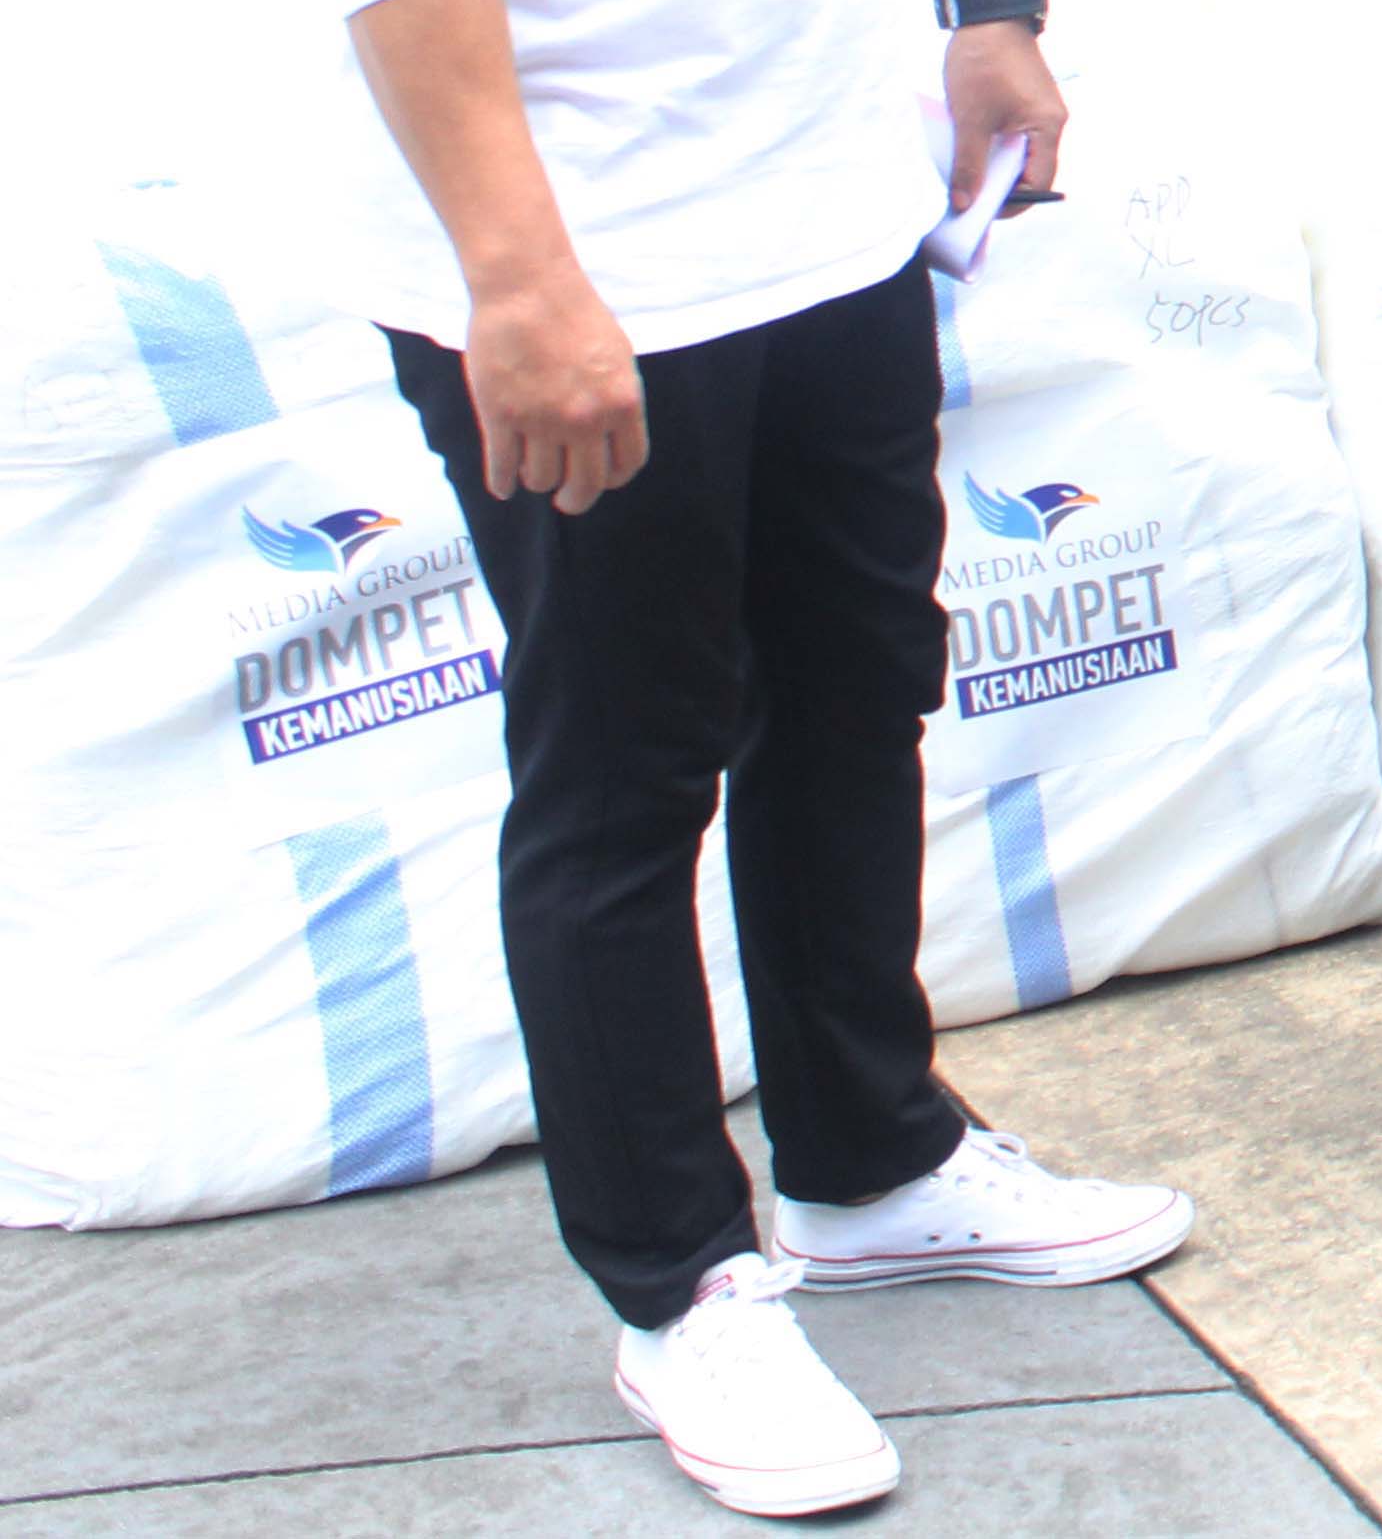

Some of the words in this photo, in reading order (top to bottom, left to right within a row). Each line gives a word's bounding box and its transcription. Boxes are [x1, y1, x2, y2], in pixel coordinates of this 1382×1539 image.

[227, 584, 347, 638] MEDIA
[357, 535, 472, 598] GROUP
[944, 552, 1047, 594] MEDIA
[1056, 520, 1161, 568] GROUP
[235, 577, 474, 714] DOMPET
[949, 563, 1165, 672] DOMPET
[258, 657, 487, 757] KEMANUSIAAN
[968, 637, 1165, 713] KEMANUSIAAN
